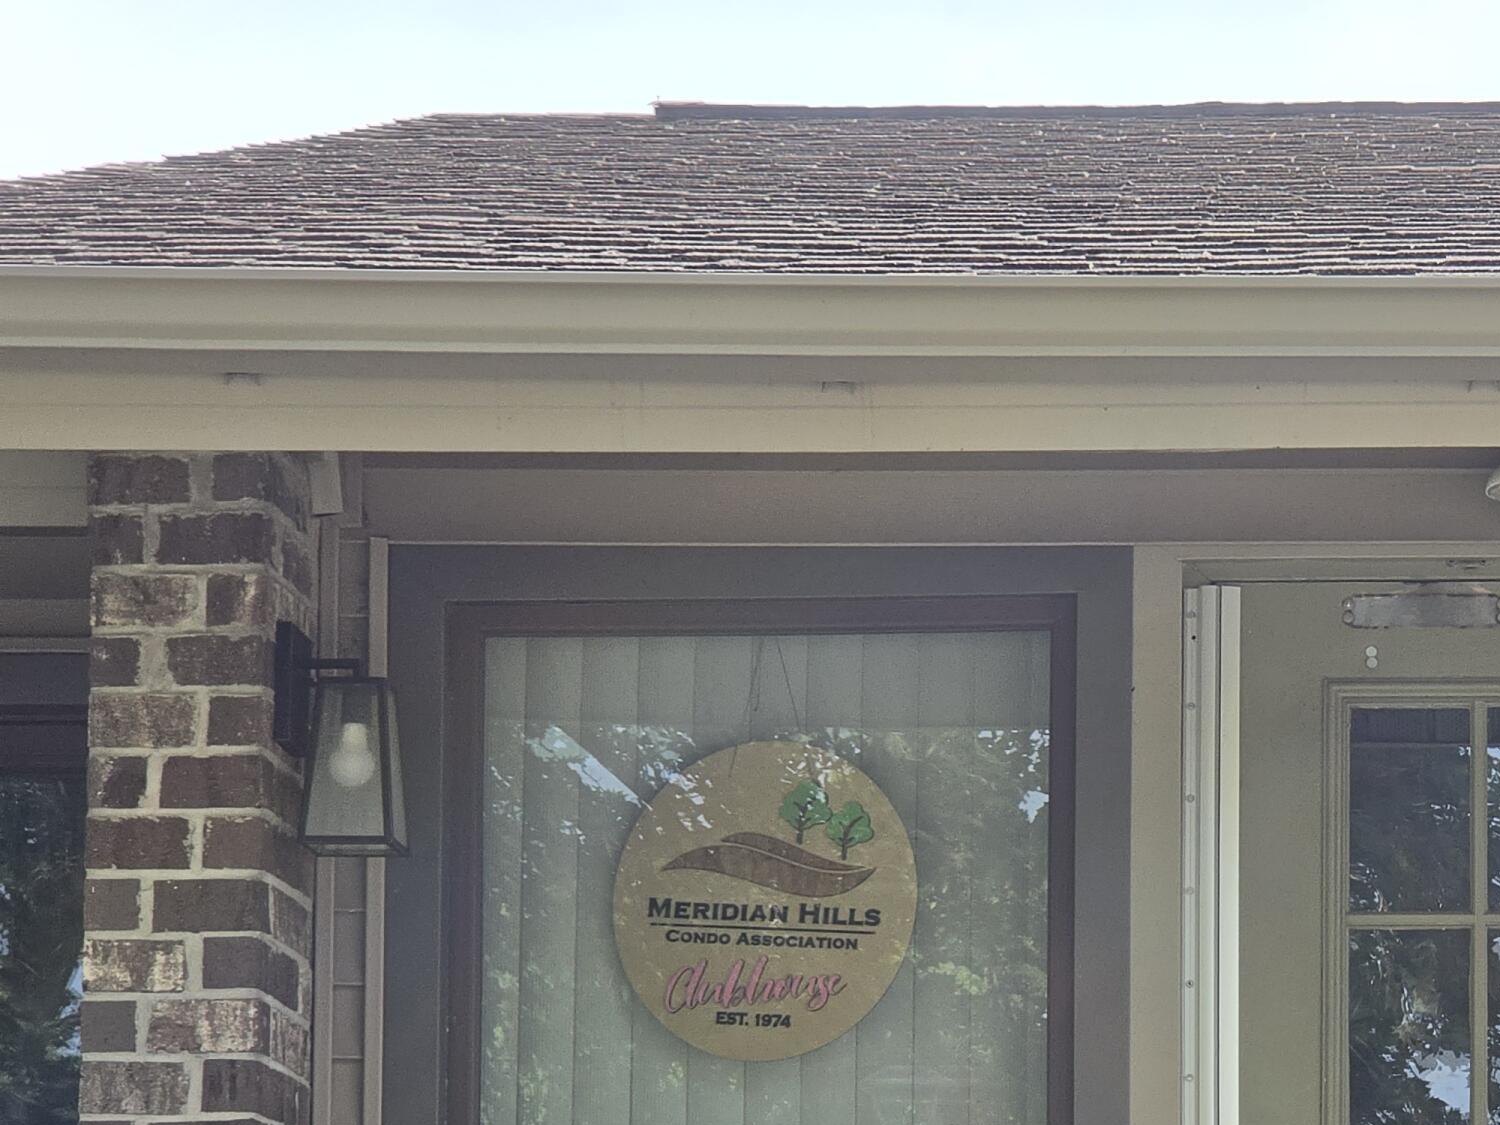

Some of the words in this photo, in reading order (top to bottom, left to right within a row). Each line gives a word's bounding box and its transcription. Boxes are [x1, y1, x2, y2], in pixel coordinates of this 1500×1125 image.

[798, 902, 882, 926] HILLS
[664, 955, 848, 1014] Clubhouse
[715, 1011, 749, 1026] EST.
[755, 1013, 791, 1028] 1974
